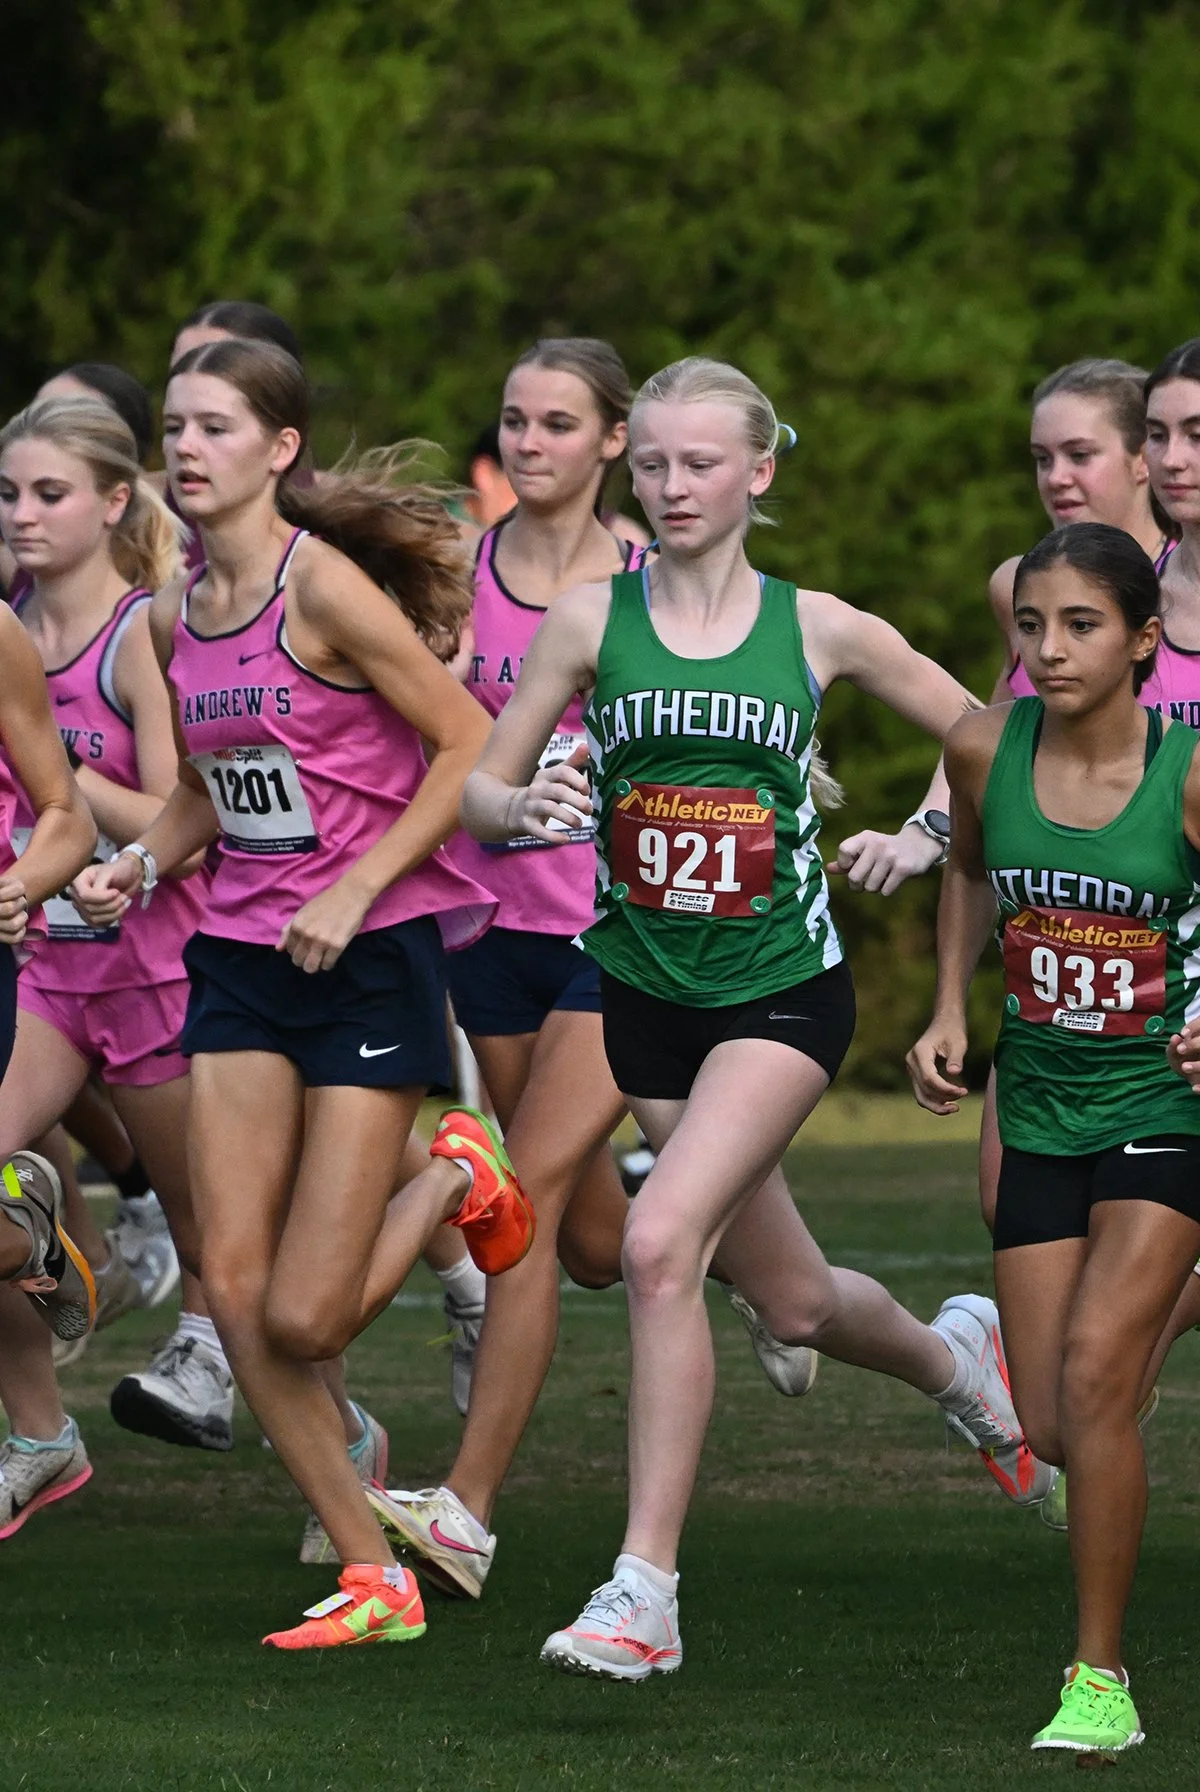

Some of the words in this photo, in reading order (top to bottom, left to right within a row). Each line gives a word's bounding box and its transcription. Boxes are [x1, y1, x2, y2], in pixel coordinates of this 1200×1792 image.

[184, 686, 292, 725] ANDREW'S
[599, 689, 801, 761] CATHEDRAL
[211, 767, 292, 815] 1201
[638, 828, 742, 893] 921
[1030, 947, 1134, 1011] 933
